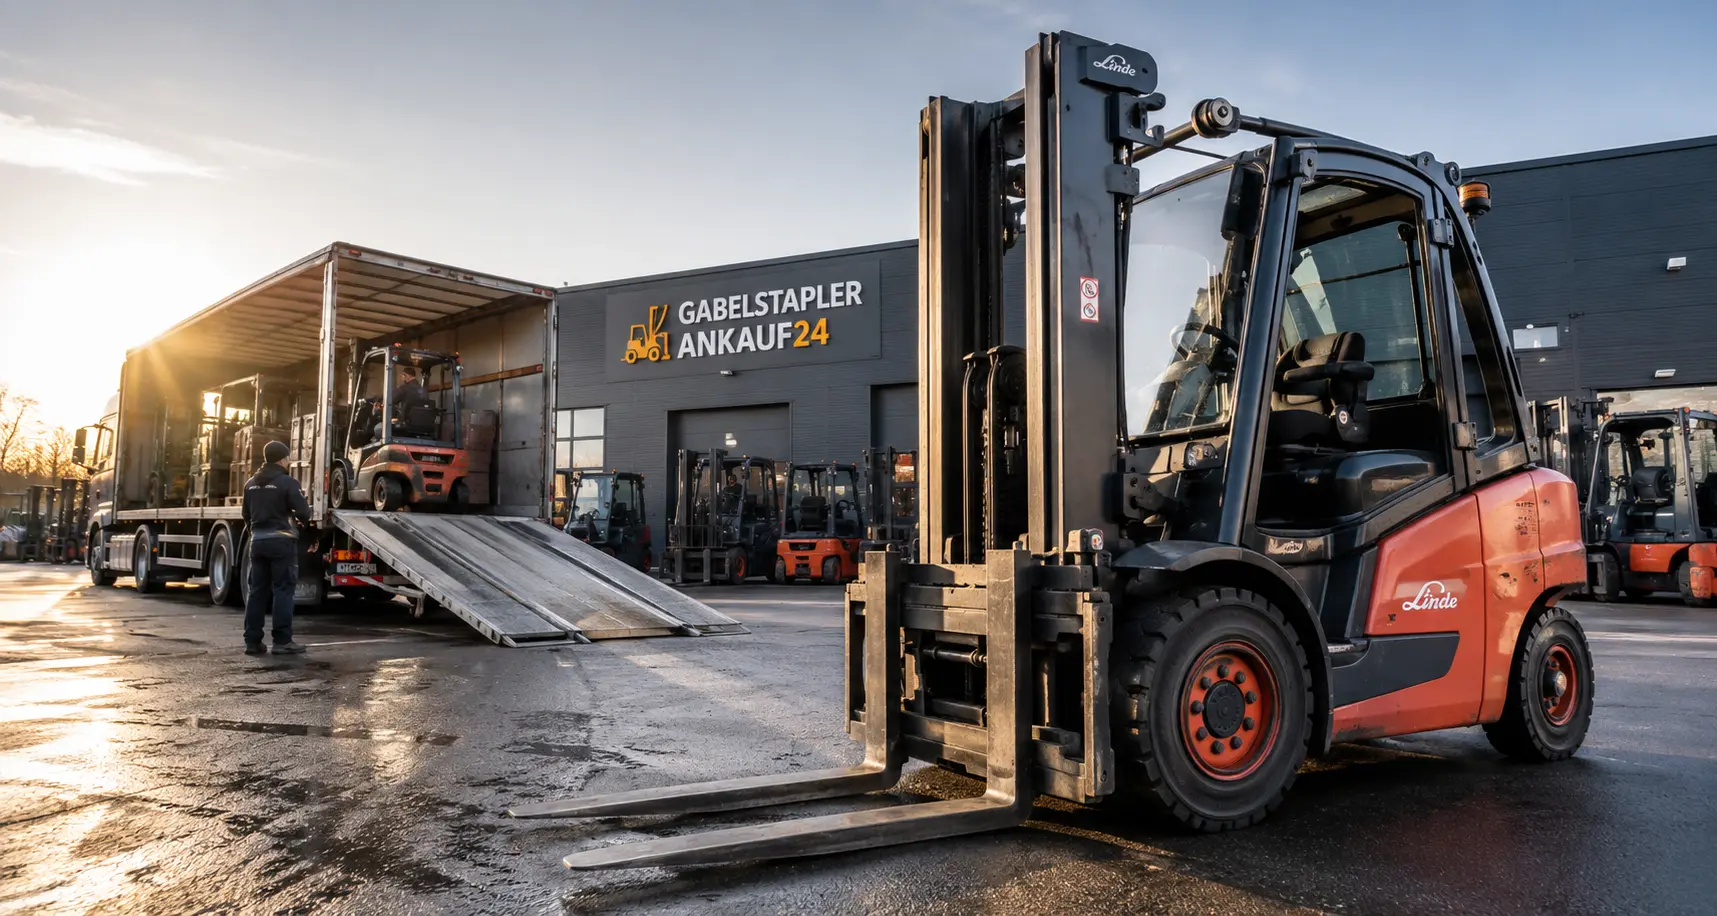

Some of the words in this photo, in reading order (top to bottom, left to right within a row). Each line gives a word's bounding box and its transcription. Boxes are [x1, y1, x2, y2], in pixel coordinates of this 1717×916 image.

[1093, 54, 1136, 76] Linde
[678, 280, 863, 325] GABELSTAPLER
[677, 317, 830, 359] ANKAUF24
[1402, 580, 1458, 611] Linde
